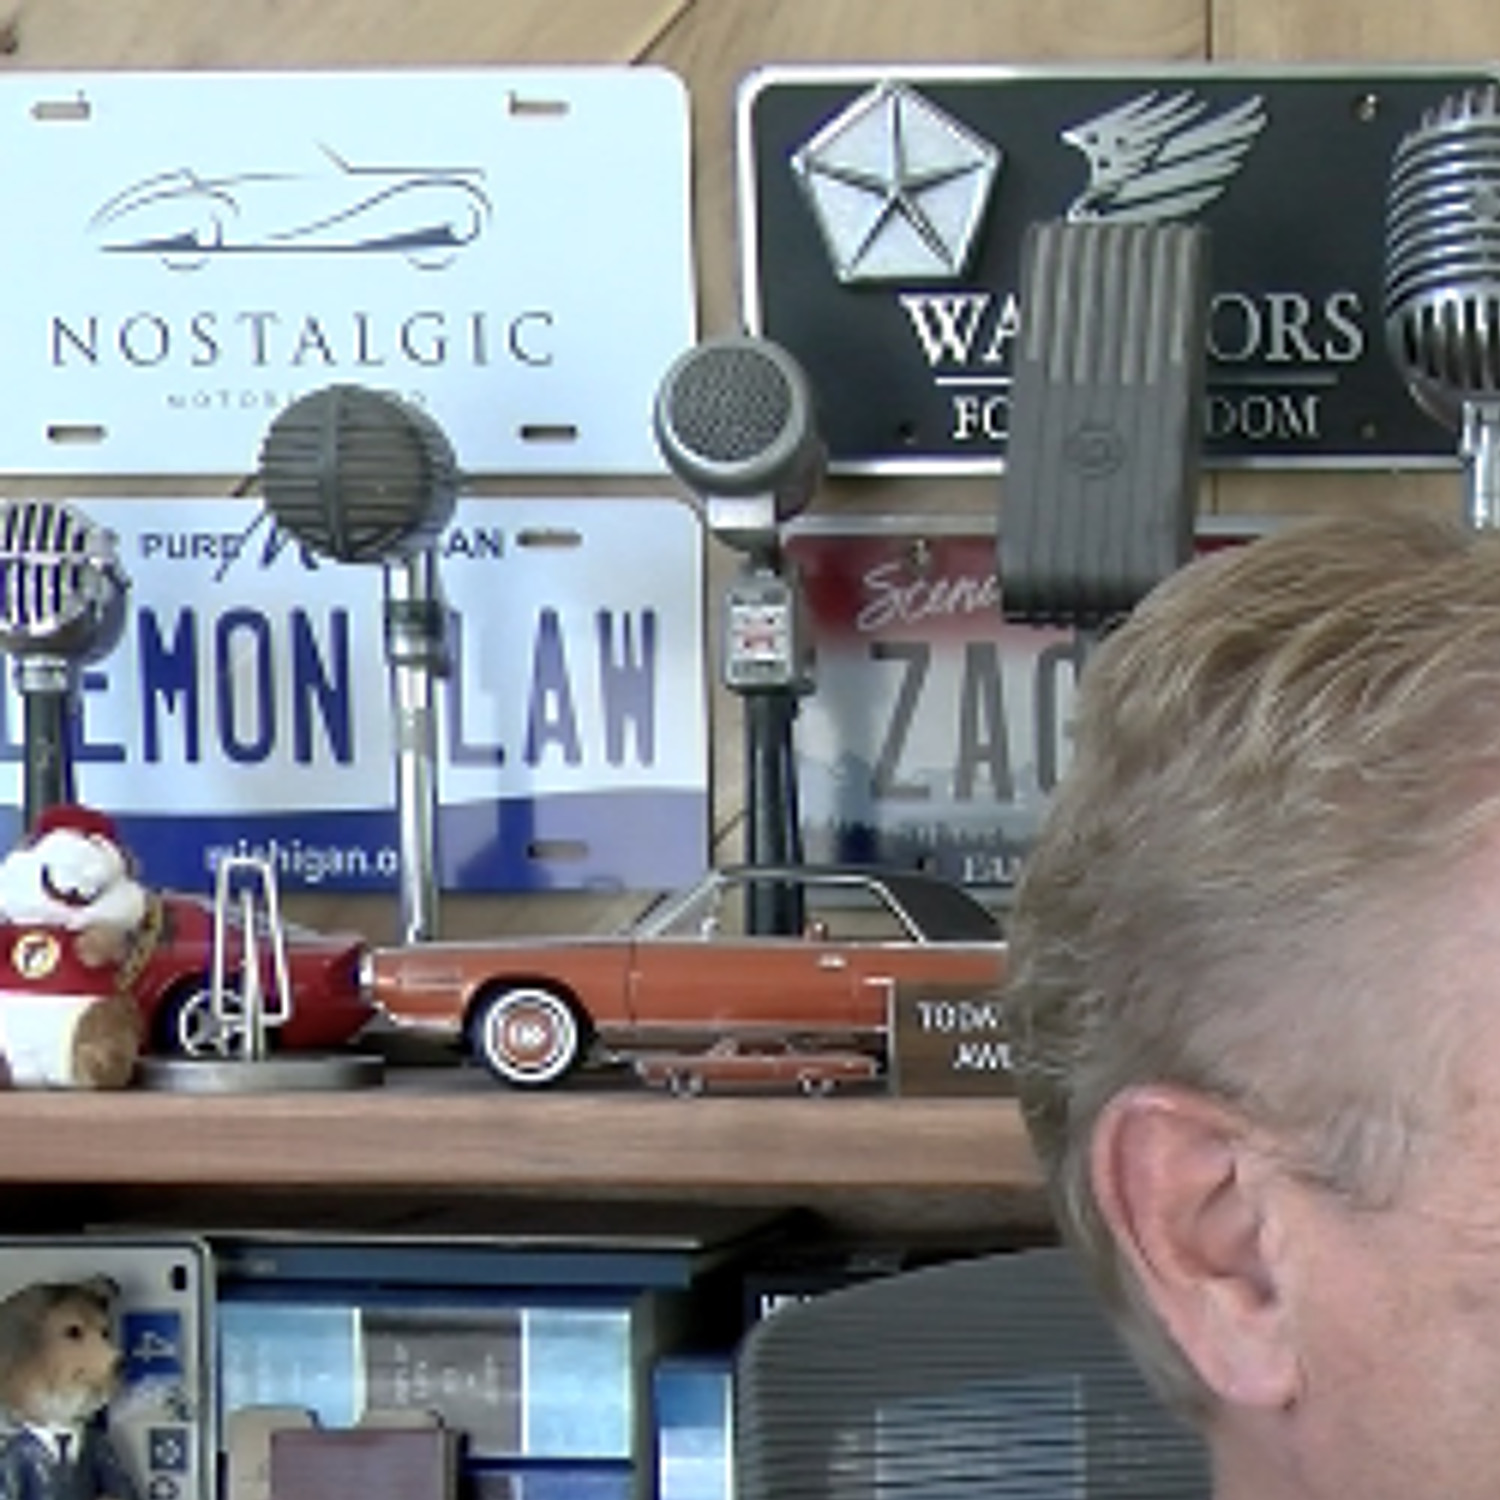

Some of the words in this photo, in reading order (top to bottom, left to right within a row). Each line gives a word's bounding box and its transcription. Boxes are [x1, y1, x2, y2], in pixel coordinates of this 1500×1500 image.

[51, 312, 554, 367] NOSTALGIC
[446, 608, 658, 768] LAW
[916, 1000, 1002, 1032] TODA
